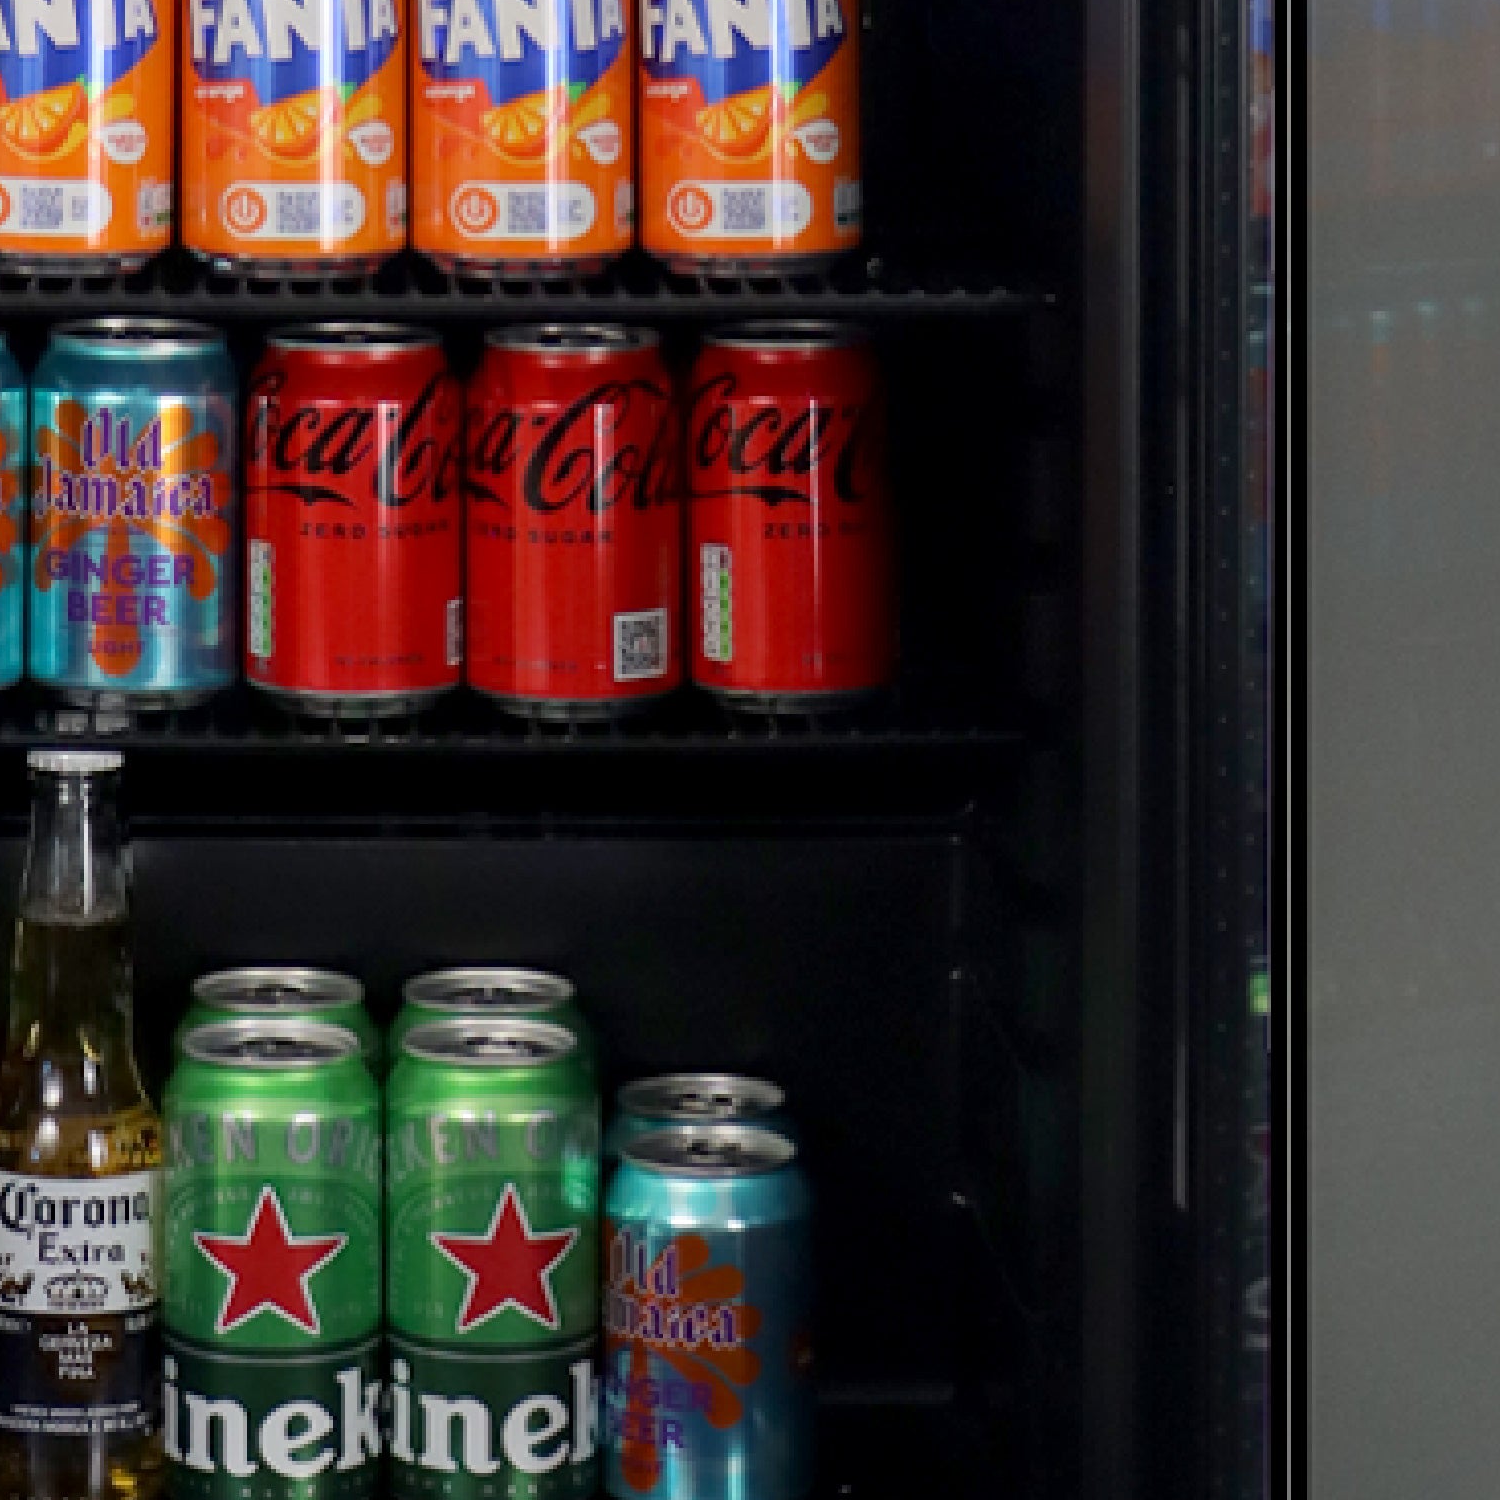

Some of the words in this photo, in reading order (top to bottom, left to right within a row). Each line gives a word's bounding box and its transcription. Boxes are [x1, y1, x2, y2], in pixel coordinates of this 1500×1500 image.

[81, 406, 163, 470] Old
[33, 452, 217, 522] Jamaica
[46, 550, 198, 587] GINGER
[67, 592, 171, 627] BEER
[37, 1231, 127, 1263] Extra
